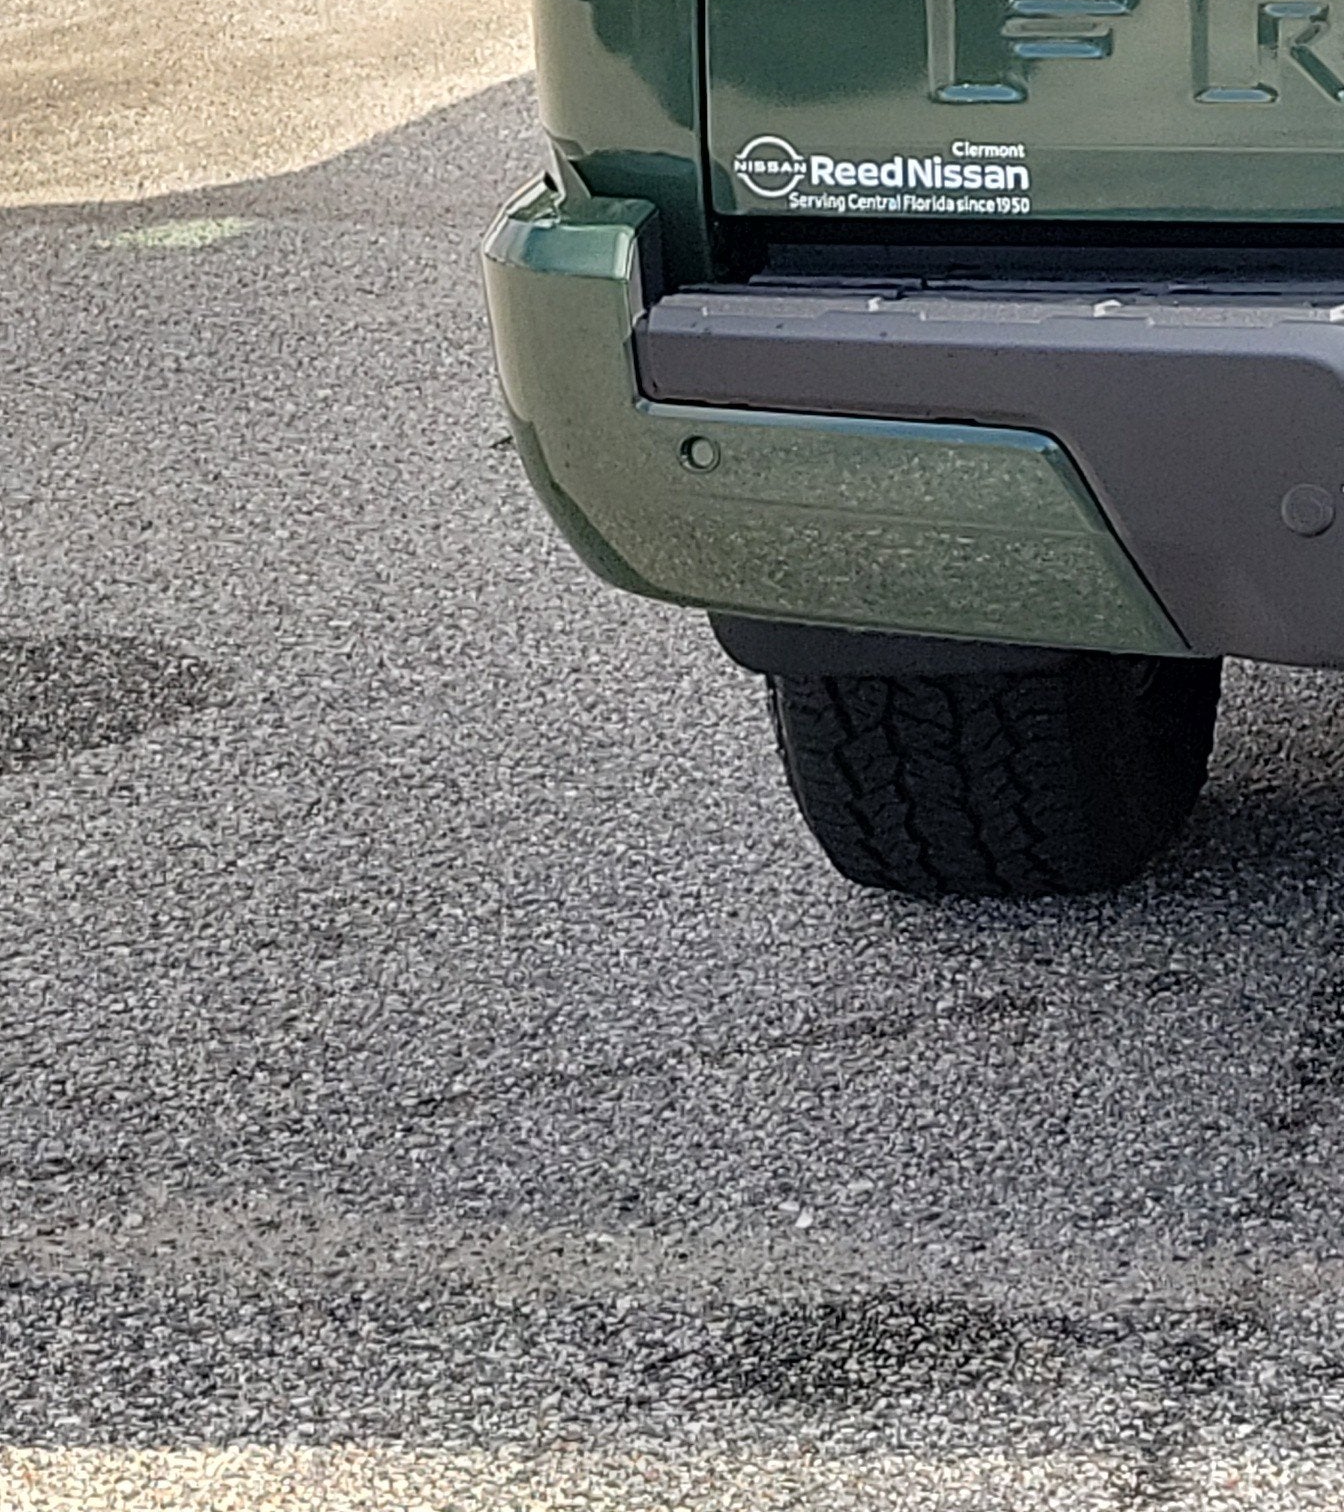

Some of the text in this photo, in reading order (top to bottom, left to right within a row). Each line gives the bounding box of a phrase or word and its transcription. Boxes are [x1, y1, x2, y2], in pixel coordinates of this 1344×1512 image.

[951, 141, 1026, 158] Clermont
[734, 160, 807, 173] NISSAN
[788, 191, 845, 213] Serving
[847, 193, 900, 211] Central
[902, 194, 954, 212] Florida
